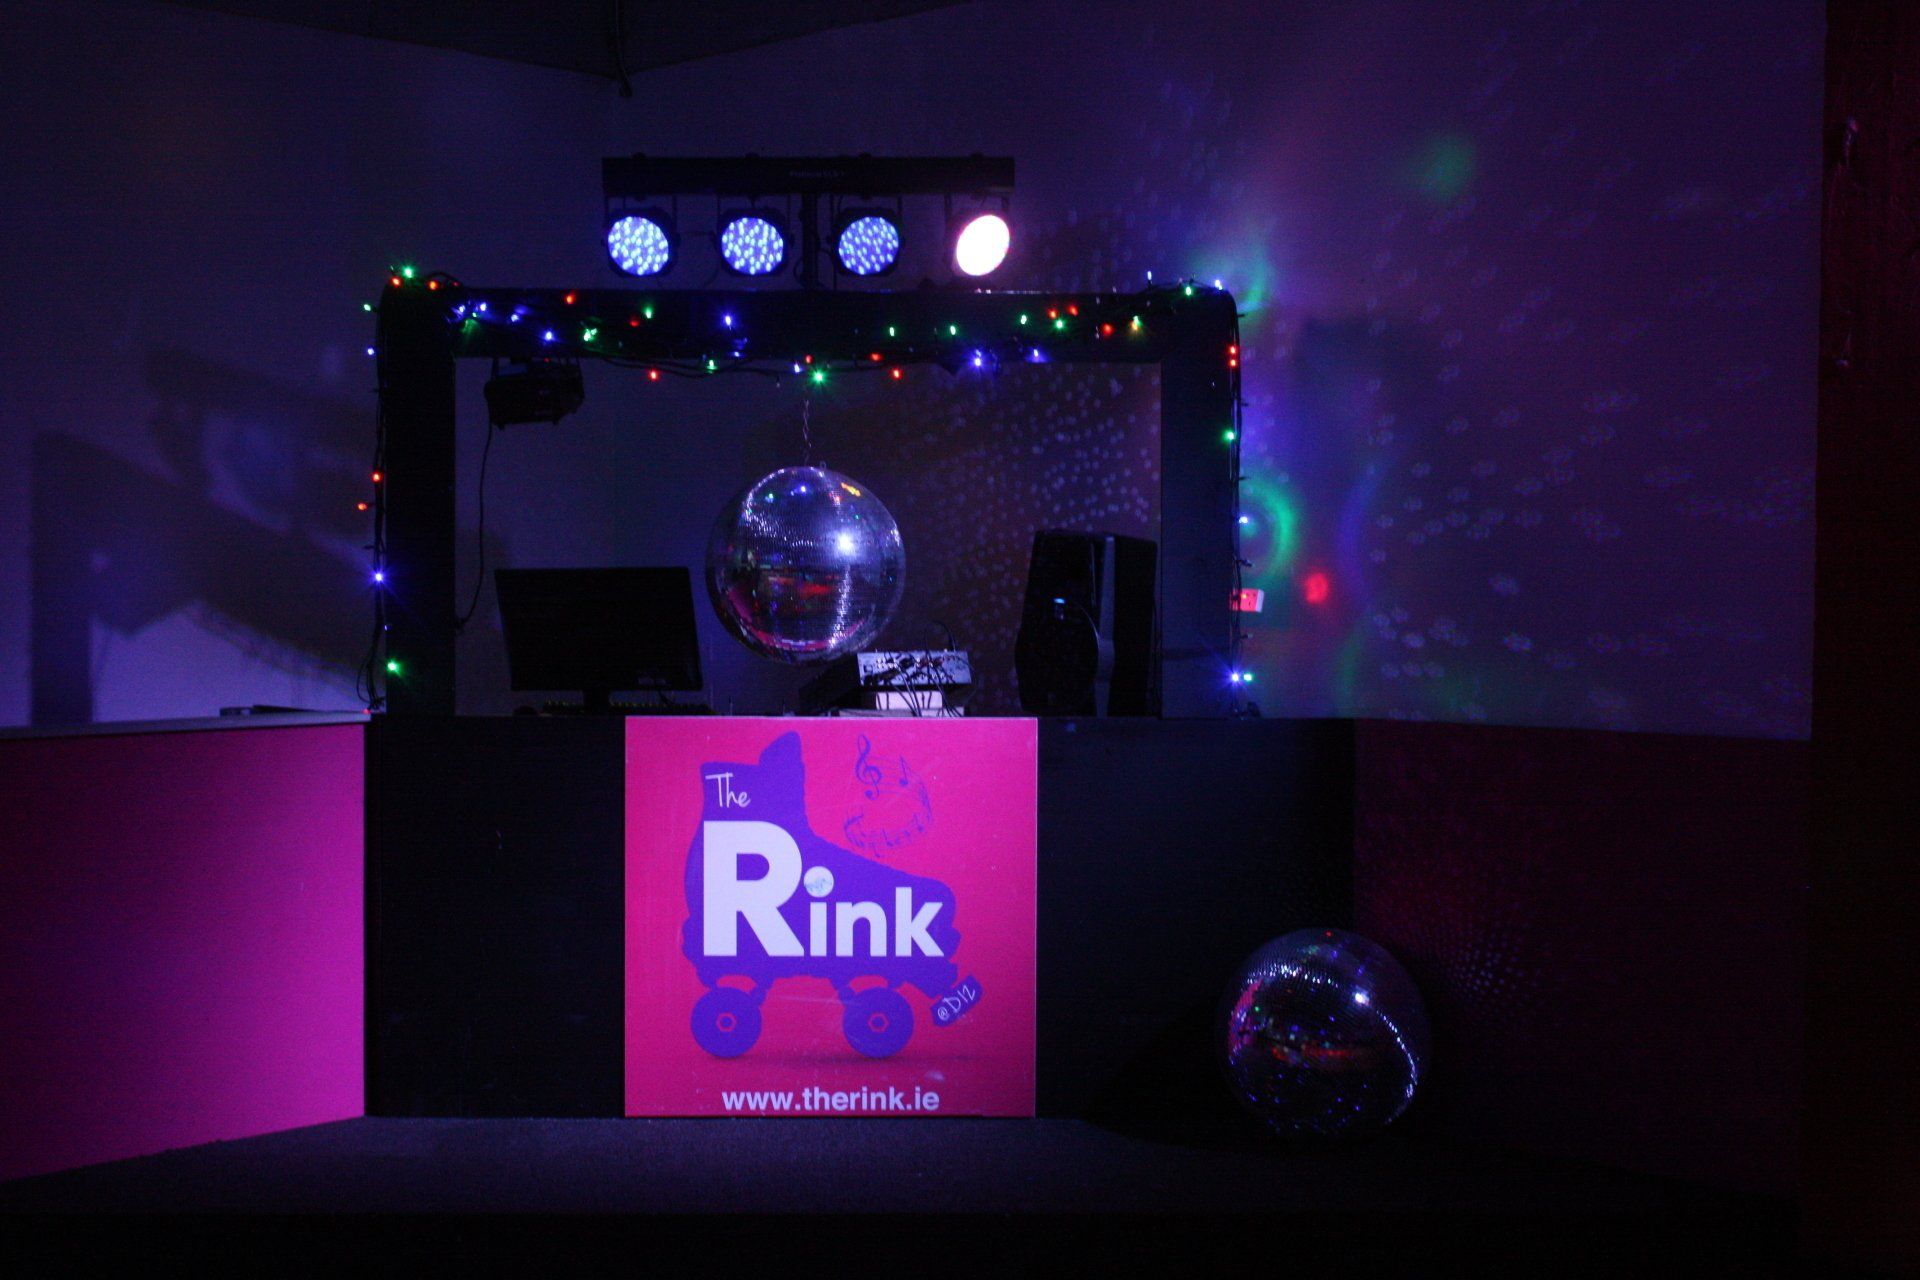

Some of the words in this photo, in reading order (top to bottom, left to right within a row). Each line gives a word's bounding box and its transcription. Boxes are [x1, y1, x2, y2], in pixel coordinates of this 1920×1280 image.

[705, 772, 751, 808] The
[703, 820, 945, 957] Rink
[937, 984, 976, 1021] @D12
[721, 1086, 940, 1111] www.therink.ie
